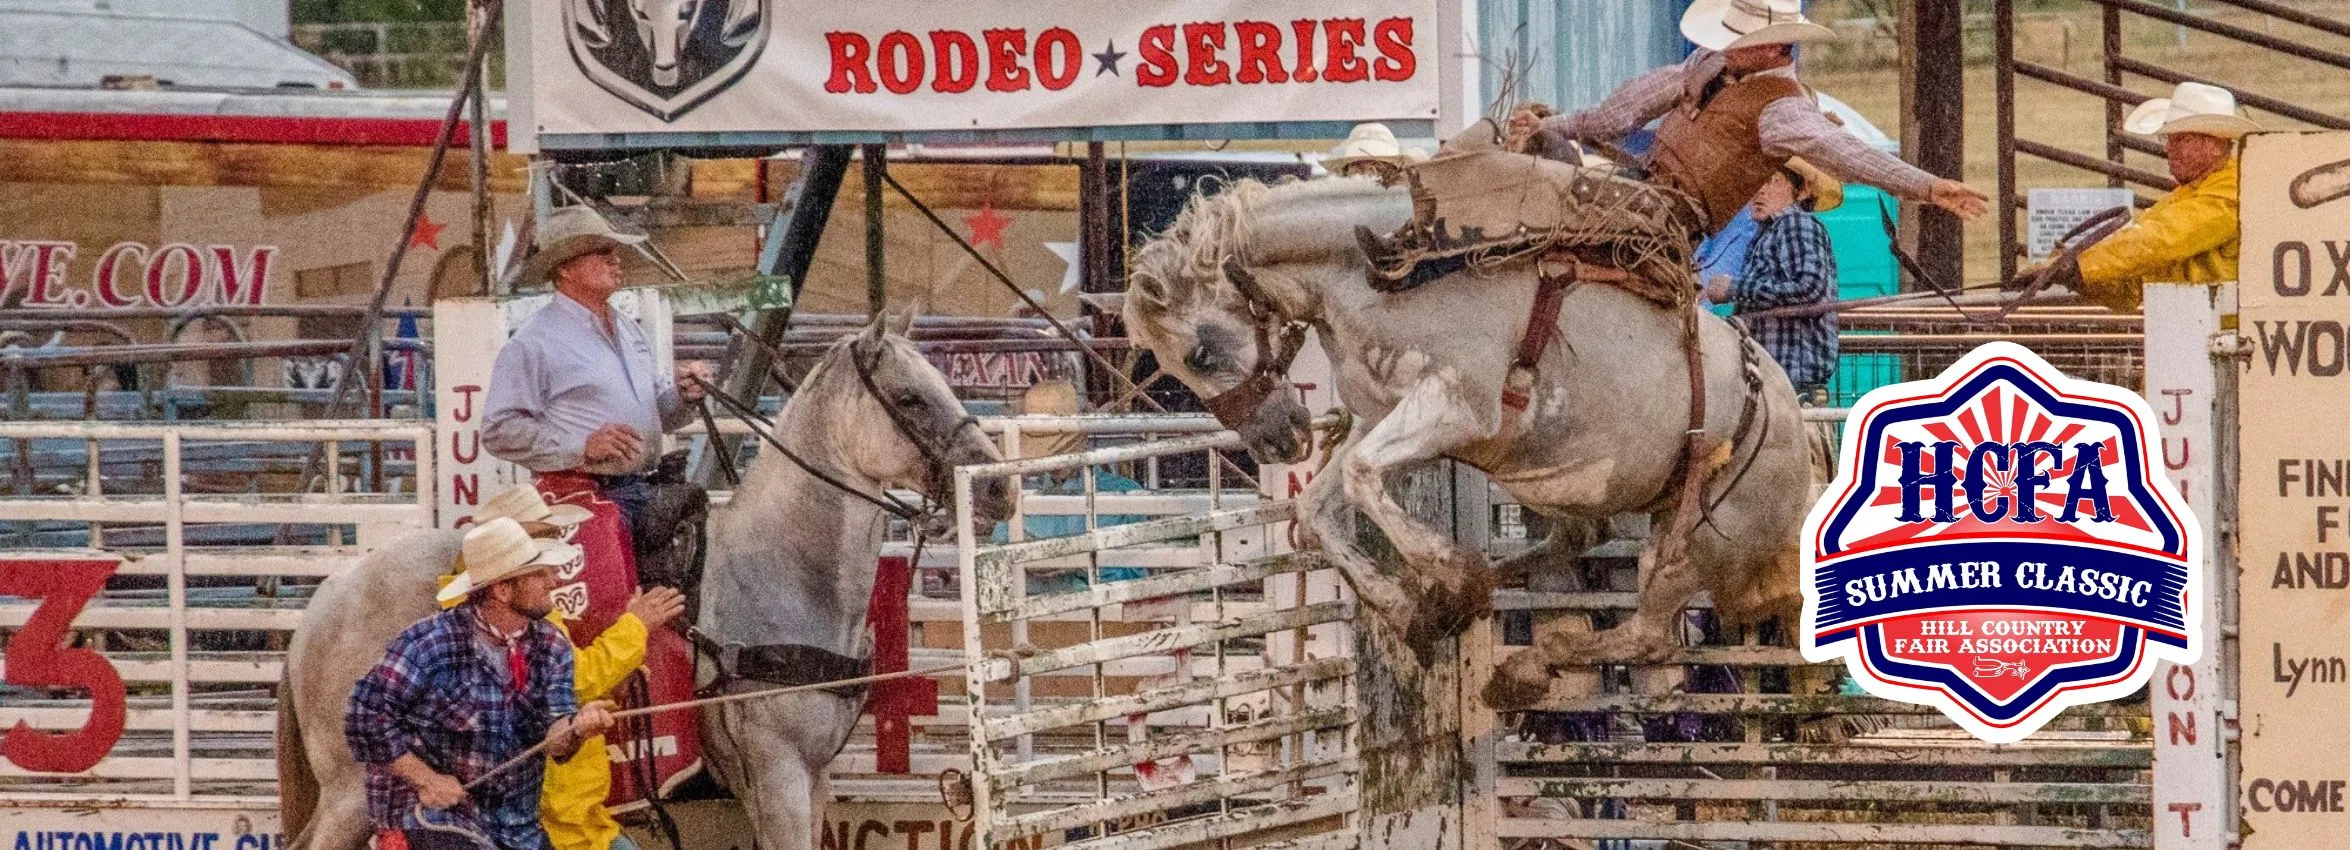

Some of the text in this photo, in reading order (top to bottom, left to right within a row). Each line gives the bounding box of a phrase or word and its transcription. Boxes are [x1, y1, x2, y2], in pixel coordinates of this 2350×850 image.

[824, 17, 1416, 94] RODEO SERIES
[2253, 320, 2350, 377] WO
[2278, 459, 2350, 497] FIN
[2317, 506, 2350, 543] F
[2271, 552, 2350, 589] AND
[0, 560, 126, 773] 3
[2273, 642, 2346, 698] Lynn
[2248, 778, 2346, 812] COME
